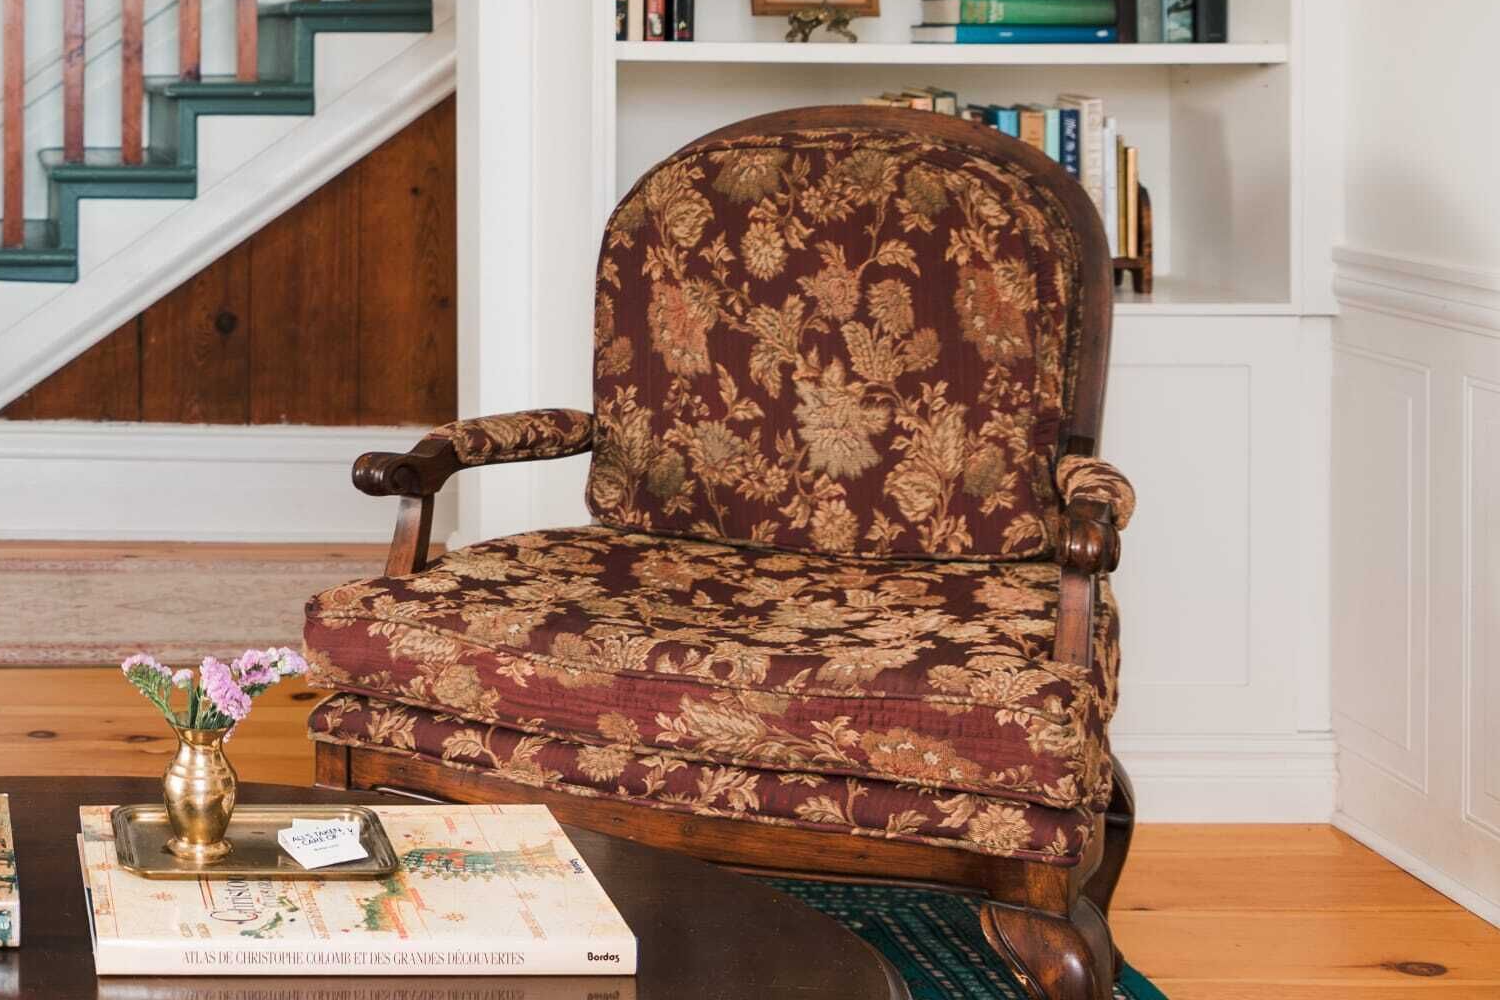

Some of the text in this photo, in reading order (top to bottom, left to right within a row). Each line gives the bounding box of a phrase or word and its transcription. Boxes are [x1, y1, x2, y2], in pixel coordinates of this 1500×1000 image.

[183, 949, 525, 965] ATLAS DE CHRISTOPHE COLOMB ET DES GRANDES DÉCOUVERTES
[586, 951, 620, 964] Bordas
